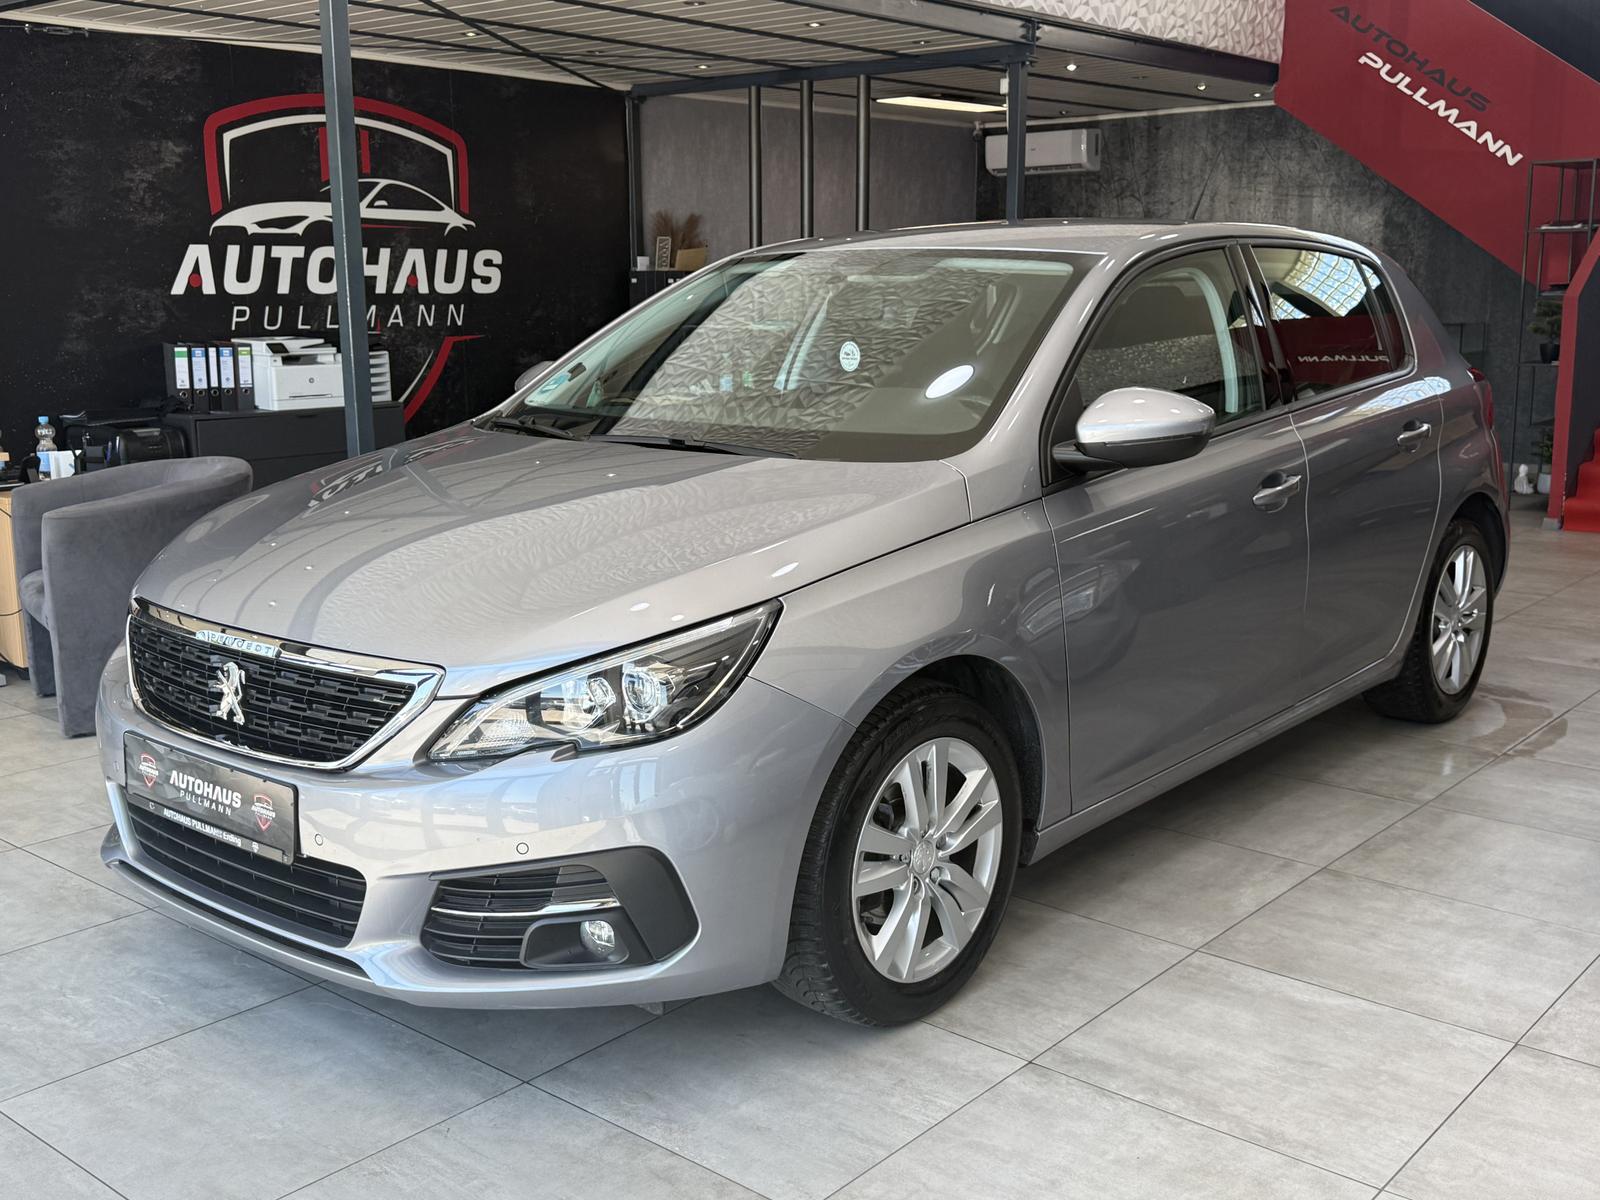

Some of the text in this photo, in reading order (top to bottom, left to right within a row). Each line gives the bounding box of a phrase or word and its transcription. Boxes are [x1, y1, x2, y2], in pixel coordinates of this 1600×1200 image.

[1329, 5, 1492, 112] AUTOHAUS
[1358, 52, 1524, 167] PULLMANN
[170, 243, 503, 295] AUTOHAUS
[169, 770, 242, 809] AUTOHAUS
[179, 790, 232, 816] PULLMANN
